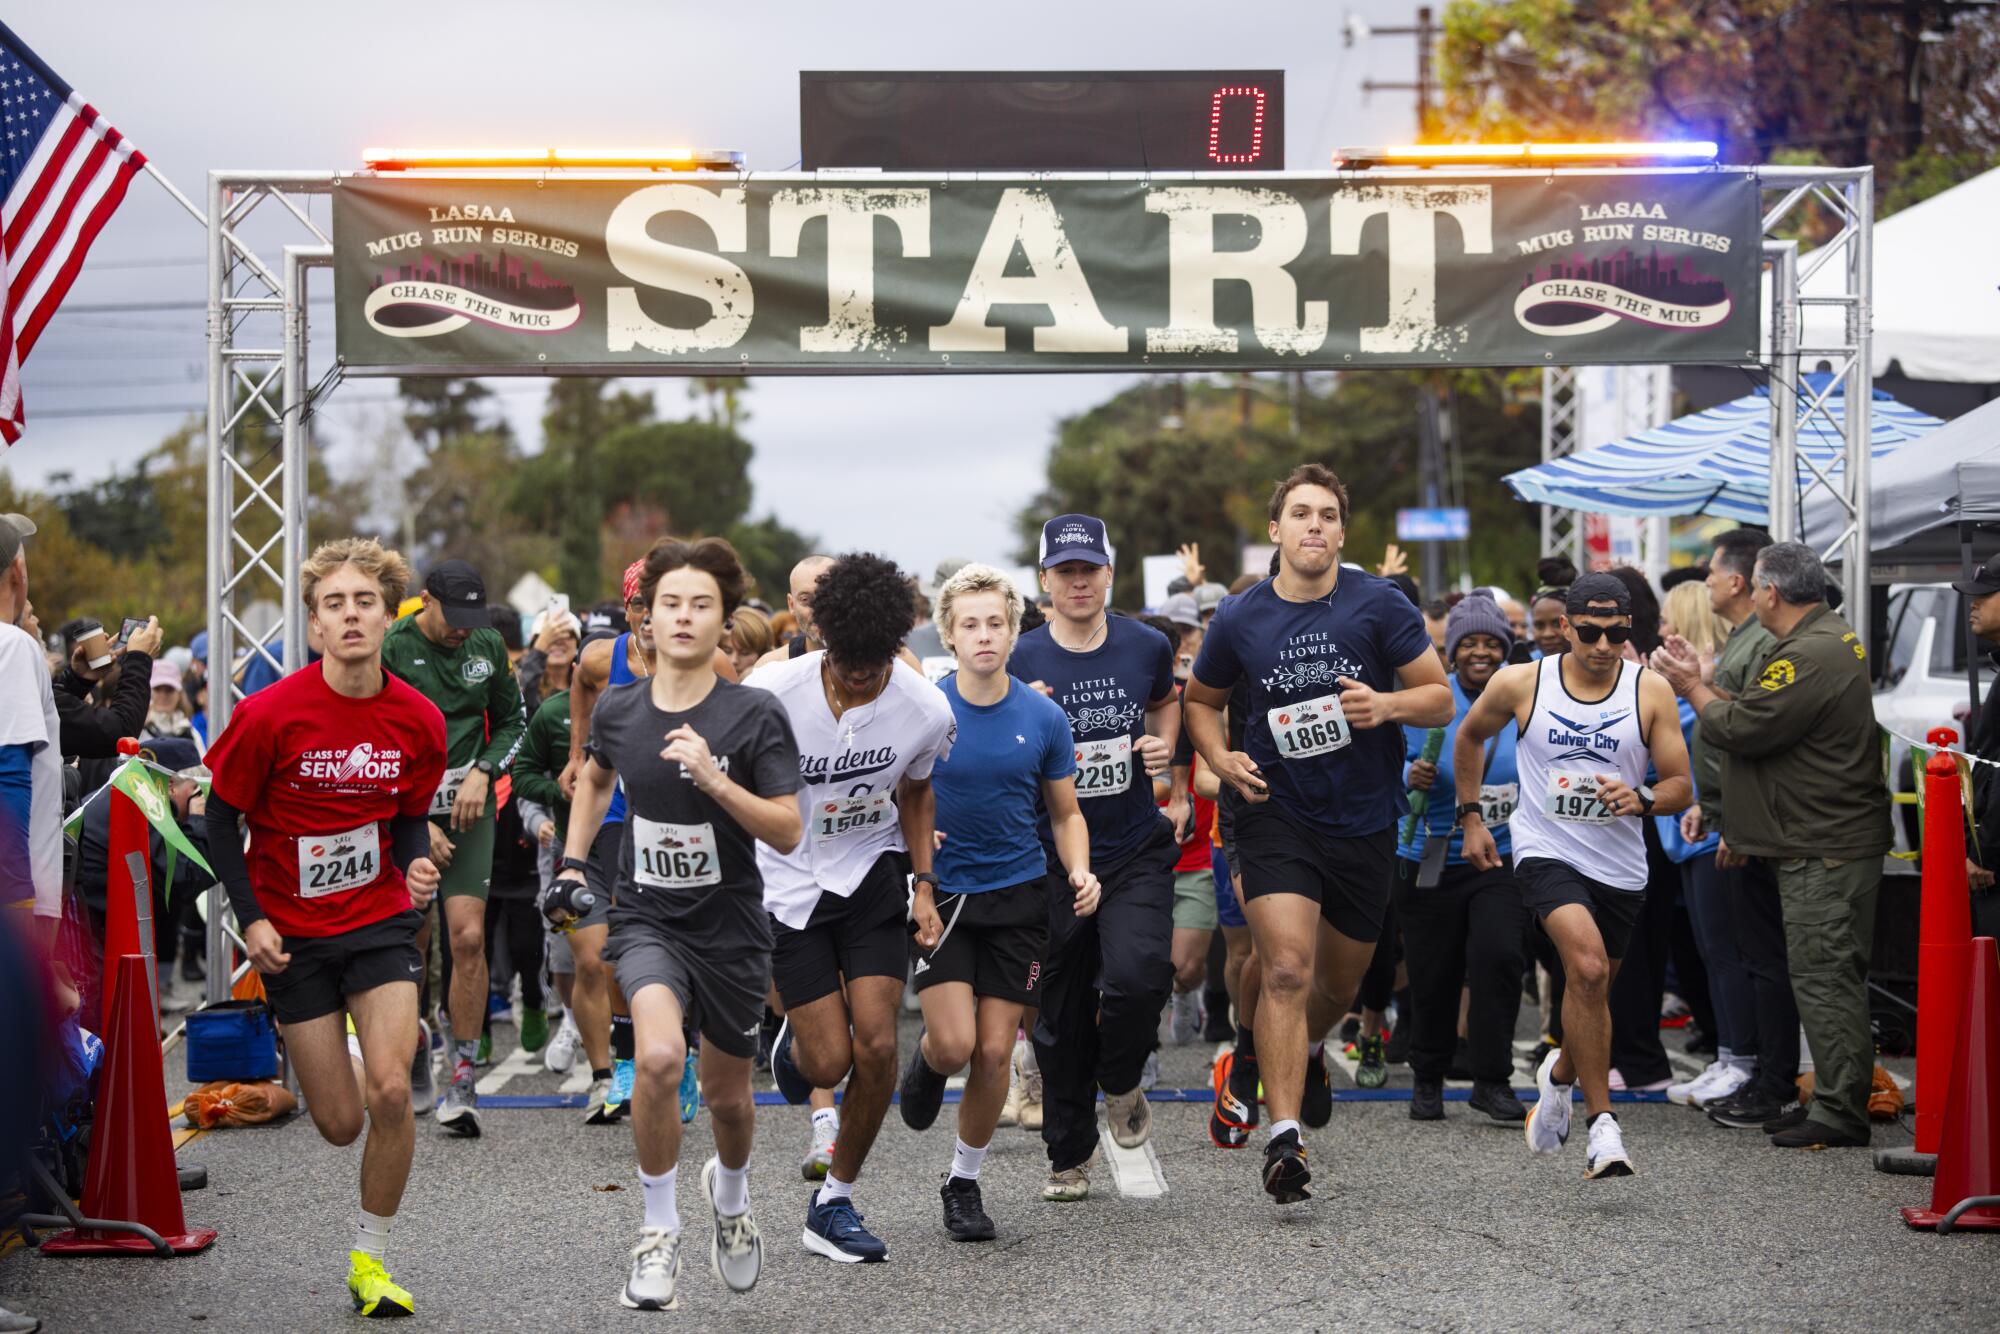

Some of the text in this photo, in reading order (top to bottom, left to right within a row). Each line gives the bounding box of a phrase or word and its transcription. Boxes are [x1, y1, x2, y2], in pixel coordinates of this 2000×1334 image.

[1209, 87, 1264, 162] 0
[429, 204, 515, 224] LASAA
[1579, 201, 1667, 221] LASAA
[366, 226, 579, 258] MUG RUN SERIES
[1517, 224, 1731, 256] MUG RUN SERIES
[605, 183, 1492, 355] START
[391, 285, 551, 328] CHASE THE MUG
[1542, 284, 1701, 323] CHASE THE MUG
[1280, 643, 1338, 660] FLOWER
[1289, 632, 1328, 646] LITTLE
[467, 662, 488, 676] LASD
[1062, 688, 1127, 705] FLOWER
[1072, 677, 1116, 691] LITTLE
[1284, 719, 1341, 752] 1869
[1548, 728, 1620, 752] Culver City
[302, 750, 401, 760] CLASS OF 2026
[1074, 761, 1127, 789] 2293
[436, 788, 456, 809] 19
[822, 810, 880, 835] 1504
[309, 851, 373, 888] 2244
[642, 847, 712, 878] 1062
